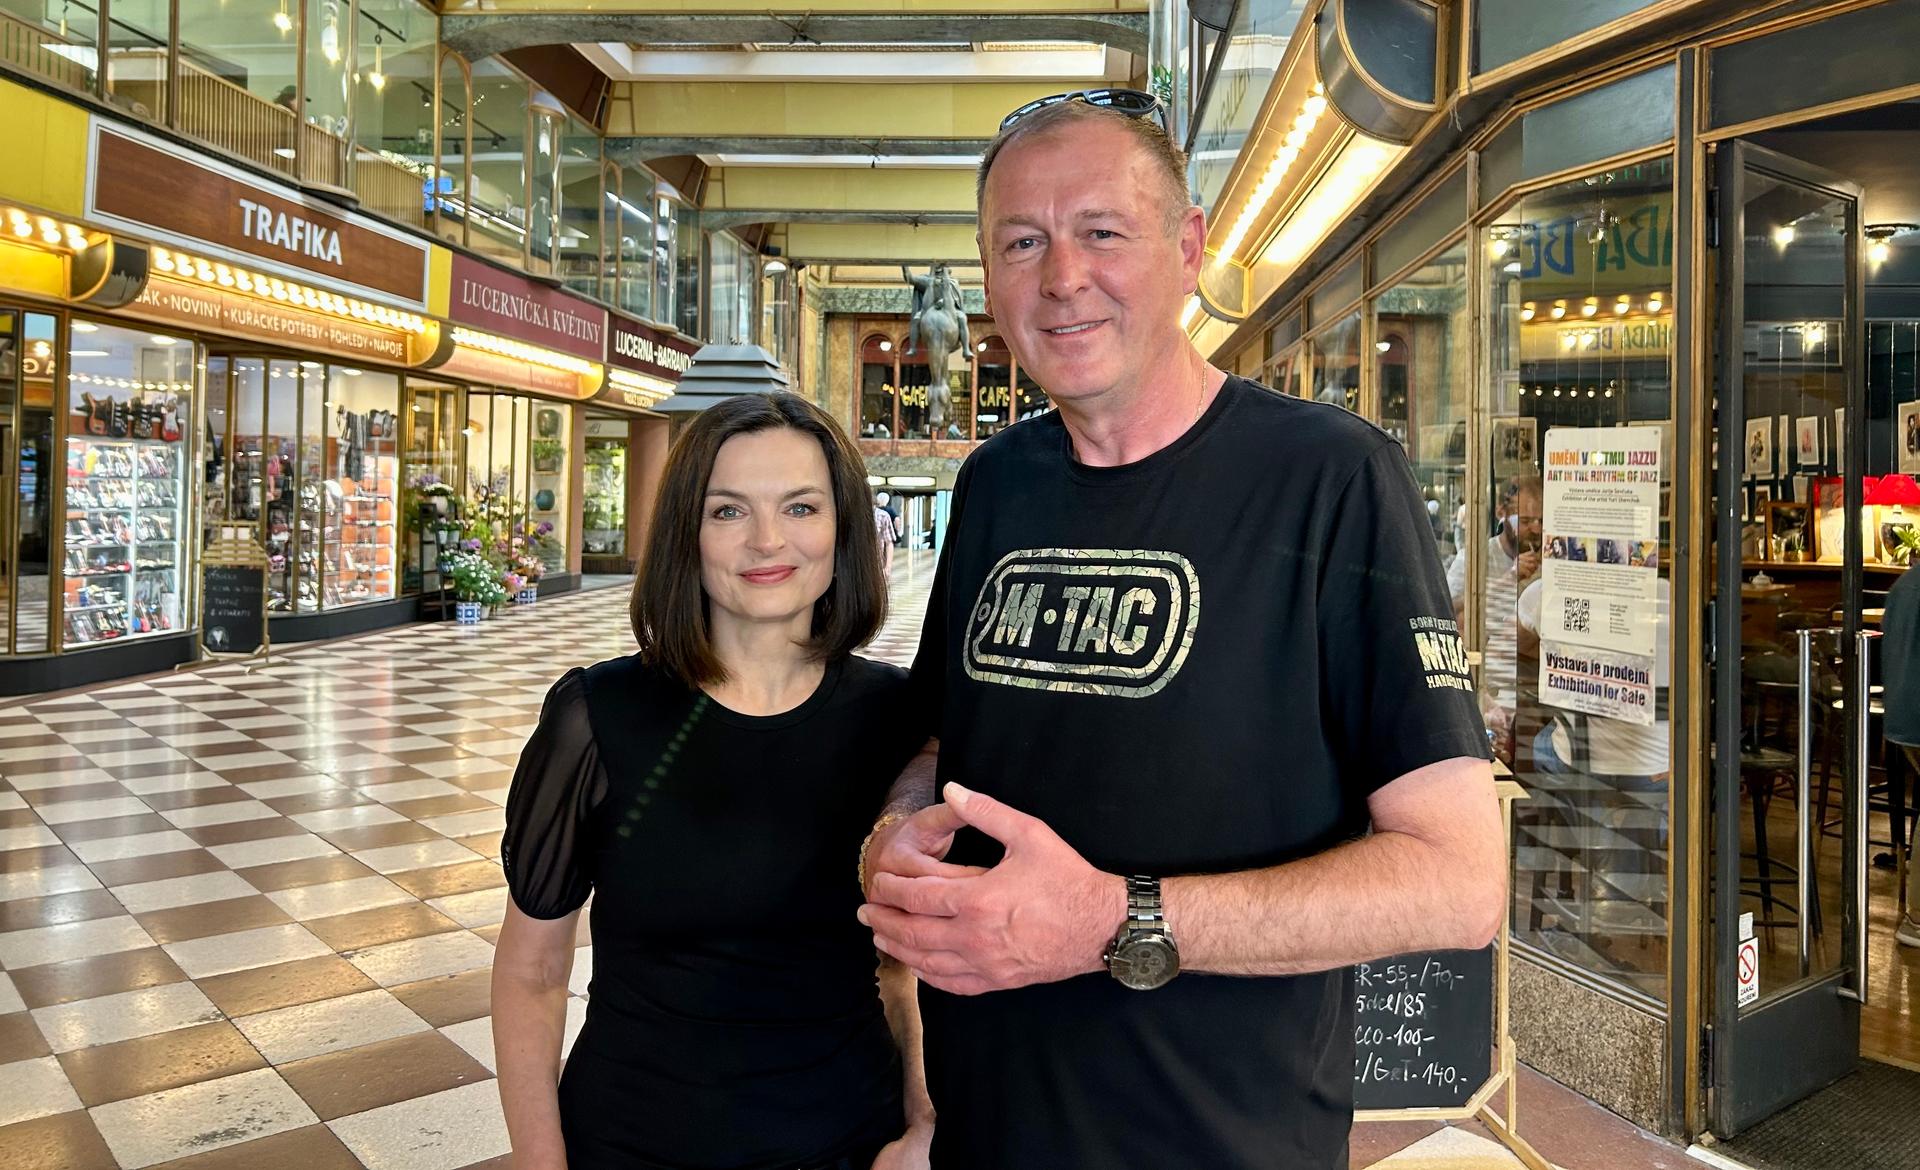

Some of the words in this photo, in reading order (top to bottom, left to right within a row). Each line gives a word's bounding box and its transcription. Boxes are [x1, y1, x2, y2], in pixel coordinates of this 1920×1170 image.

[239, 198, 343, 266] TRAFIKA
[171, 294, 221, 320] NOVINY
[281, 317, 323, 340] POTŘEBY
[330, 328, 368, 348] POHLEDY
[373, 335, 403, 358] NÁPOJE
[462, 280, 550, 329] LUCERNIČKA
[552, 309, 600, 344] KVĚTINY
[1549, 449, 1580, 466] UMĚNÍ
[1582, 451, 1589, 465] V
[1627, 451, 1657, 466] JAZZU
[1548, 469, 1563, 481] ART
[1564, 470, 1573, 481] IN
[1574, 470, 1589, 481] THE
[1590, 470, 1625, 483] RHYTHM
[1627, 470, 1639, 483] OF
[1640, 470, 1658, 483] JAZZ
[1546, 652, 1588, 673] Výstava
[1590, 660, 1601, 676] je
[1603, 664, 1649, 685] prodejní
[1548, 673, 1602, 699] Exhibition
[1604, 684, 1619, 701] for
[1621, 687, 1646, 706] Sale
